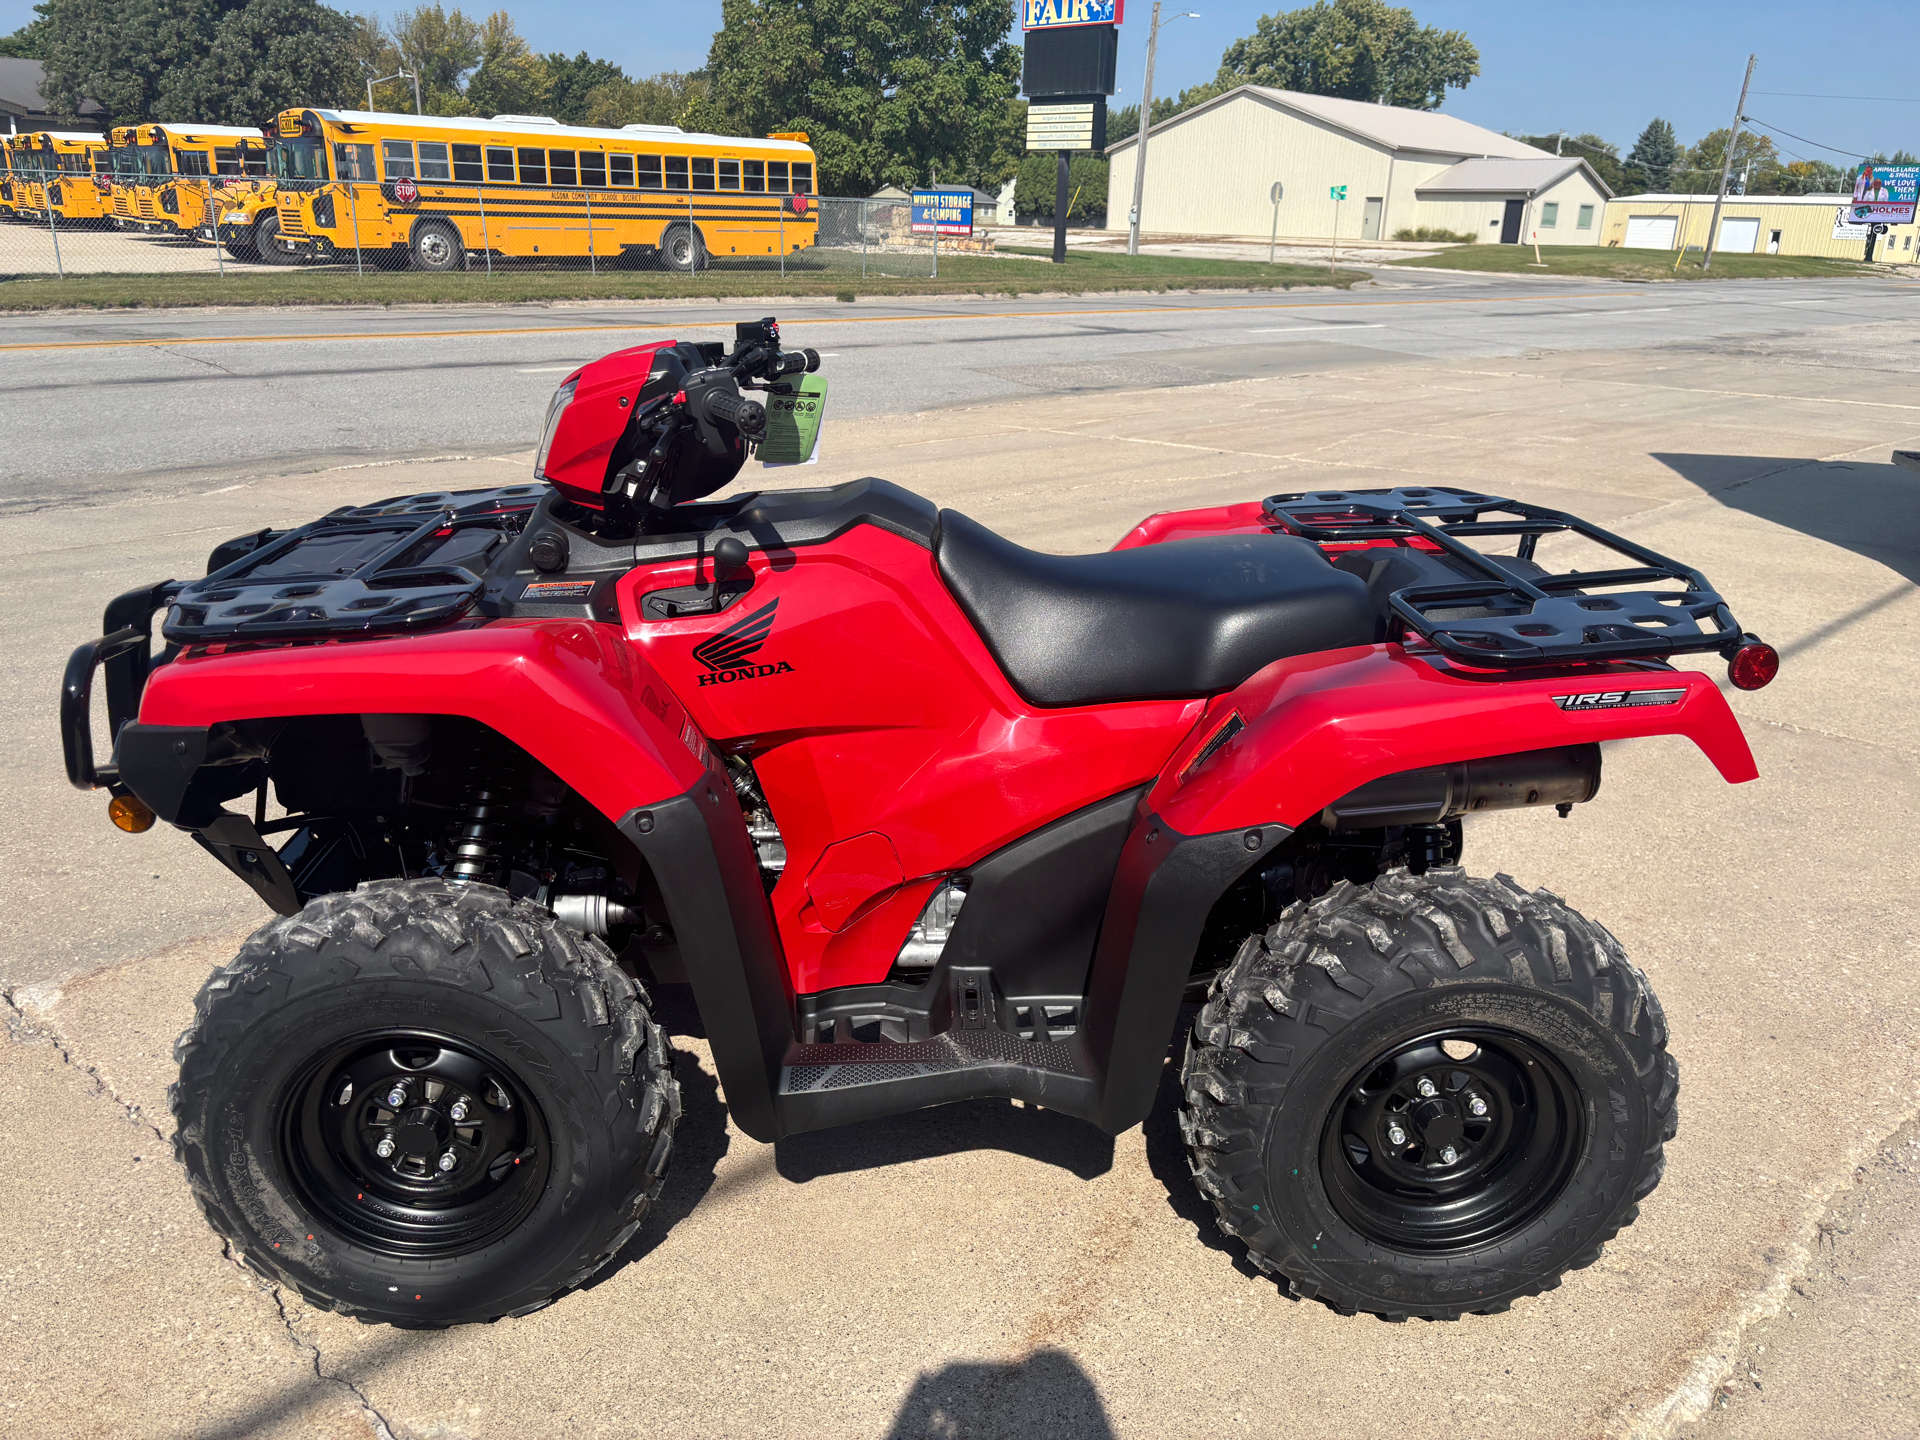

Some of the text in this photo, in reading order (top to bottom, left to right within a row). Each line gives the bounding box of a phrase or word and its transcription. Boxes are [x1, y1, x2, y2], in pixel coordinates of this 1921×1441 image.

[1026, 0, 1090, 25] FAIR
[1898, 179, 1917, 187] LOVE
[396, 185, 415, 196] STOP
[551, 192, 569, 200] ALGONA
[601, 193, 618, 201] SCHOOL
[622, 194, 641, 202] DISTRICT
[940, 195, 971, 209] STORAGE
[922, 209, 962, 222] & CAMPING
[1873, 206, 1910, 214] HOLMES
[697, 661, 796, 687] HONDA
[1565, 691, 1625, 706] IRS
